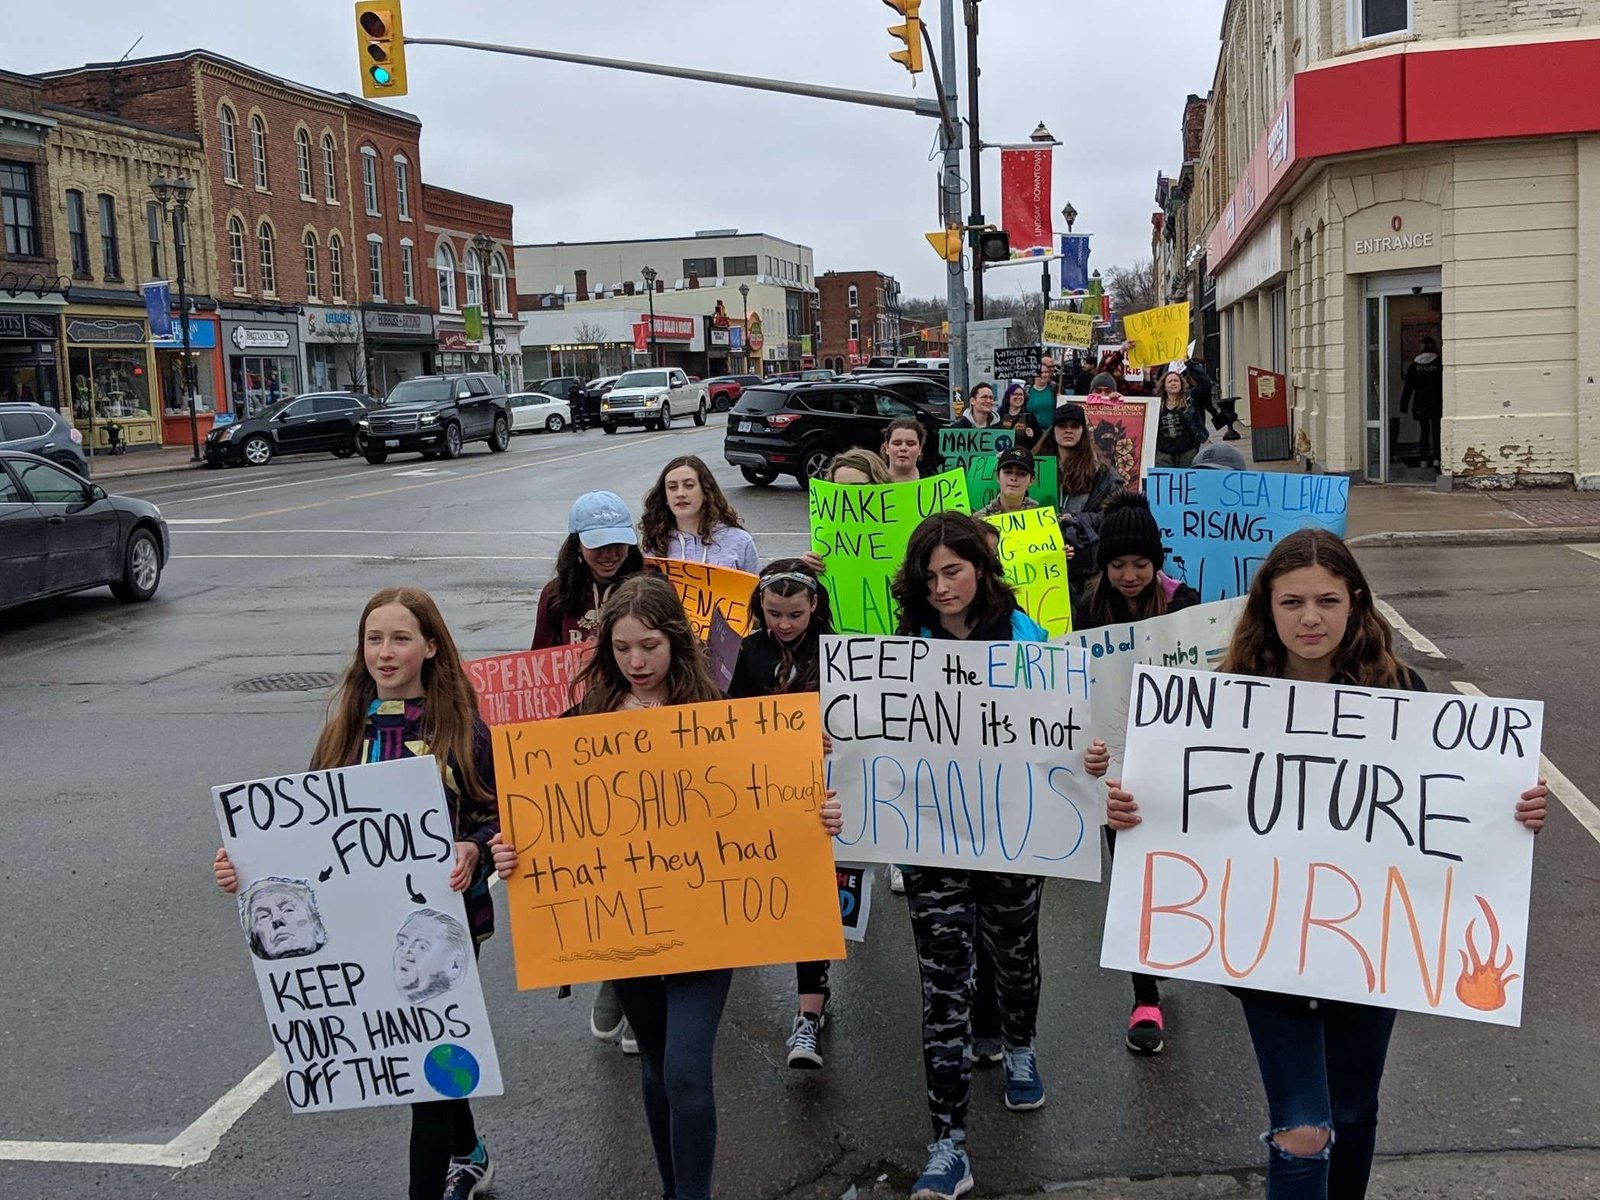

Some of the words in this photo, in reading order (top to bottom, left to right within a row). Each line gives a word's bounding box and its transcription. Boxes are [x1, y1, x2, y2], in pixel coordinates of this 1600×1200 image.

[1034, 150, 1042, 202] DOWNTOWN
[1034, 205, 1042, 237] LINDSAY
[1355, 232, 1434, 255] ENTRANCE
[996, 349, 1028, 358] WITHOUT
[942, 432, 993, 452] MAKE
[973, 457, 1047, 488] PLT
[1149, 471, 1198, 505] THE
[1220, 472, 1270, 507] SEA
[1282, 474, 1349, 515] LEVELS
[815, 489, 898, 523] WAKE
[1037, 509, 1056, 527] IS
[1183, 510, 1273, 542] RISING
[814, 526, 893, 560] SAVE
[1028, 534, 1057, 554] and
[661, 560, 716, 587] ECT
[1003, 562, 1037, 585] RLD
[1044, 563, 1060, 579] is
[1076, 626, 1134, 658] lobal
[470, 653, 549, 693] SPEAK
[824, 638, 929, 683] KEEP
[942, 654, 982, 685] the
[988, 643, 1088, 700] EARTH
[485, 690, 511, 723] THE
[513, 687, 560, 719] TREES
[824, 691, 962, 745] CLEAN
[980, 701, 1017, 747] it's
[1030, 707, 1081, 750] not
[1135, 672, 1270, 729] DON'T
[1285, 685, 1410, 741] LET
[1432, 700, 1532, 758] OUR
[505, 730, 552, 779] I'm
[574, 728, 652, 766] sure
[670, 705, 738, 748] that
[755, 701, 805, 735] the
[219, 772, 382, 837] FOSSIL
[507, 765, 738, 855] DINOSAURS
[827, 756, 1085, 861] URANUS
[1182, 746, 1470, 862] FUTURE
[331, 809, 451, 875] FOOLS
[524, 848, 607, 893] that
[624, 840, 705, 888] they
[716, 829, 778, 865] had
[531, 886, 675, 950] TIME
[707, 876, 790, 925] TOO
[1138, 850, 1453, 1008] BURN
[269, 963, 365, 1013] KEEP
[272, 1016, 357, 1064] YOUR
[363, 1004, 471, 1050] HANDS
[286, 1060, 341, 1108] OFF
[344, 1056, 414, 1100] THE
